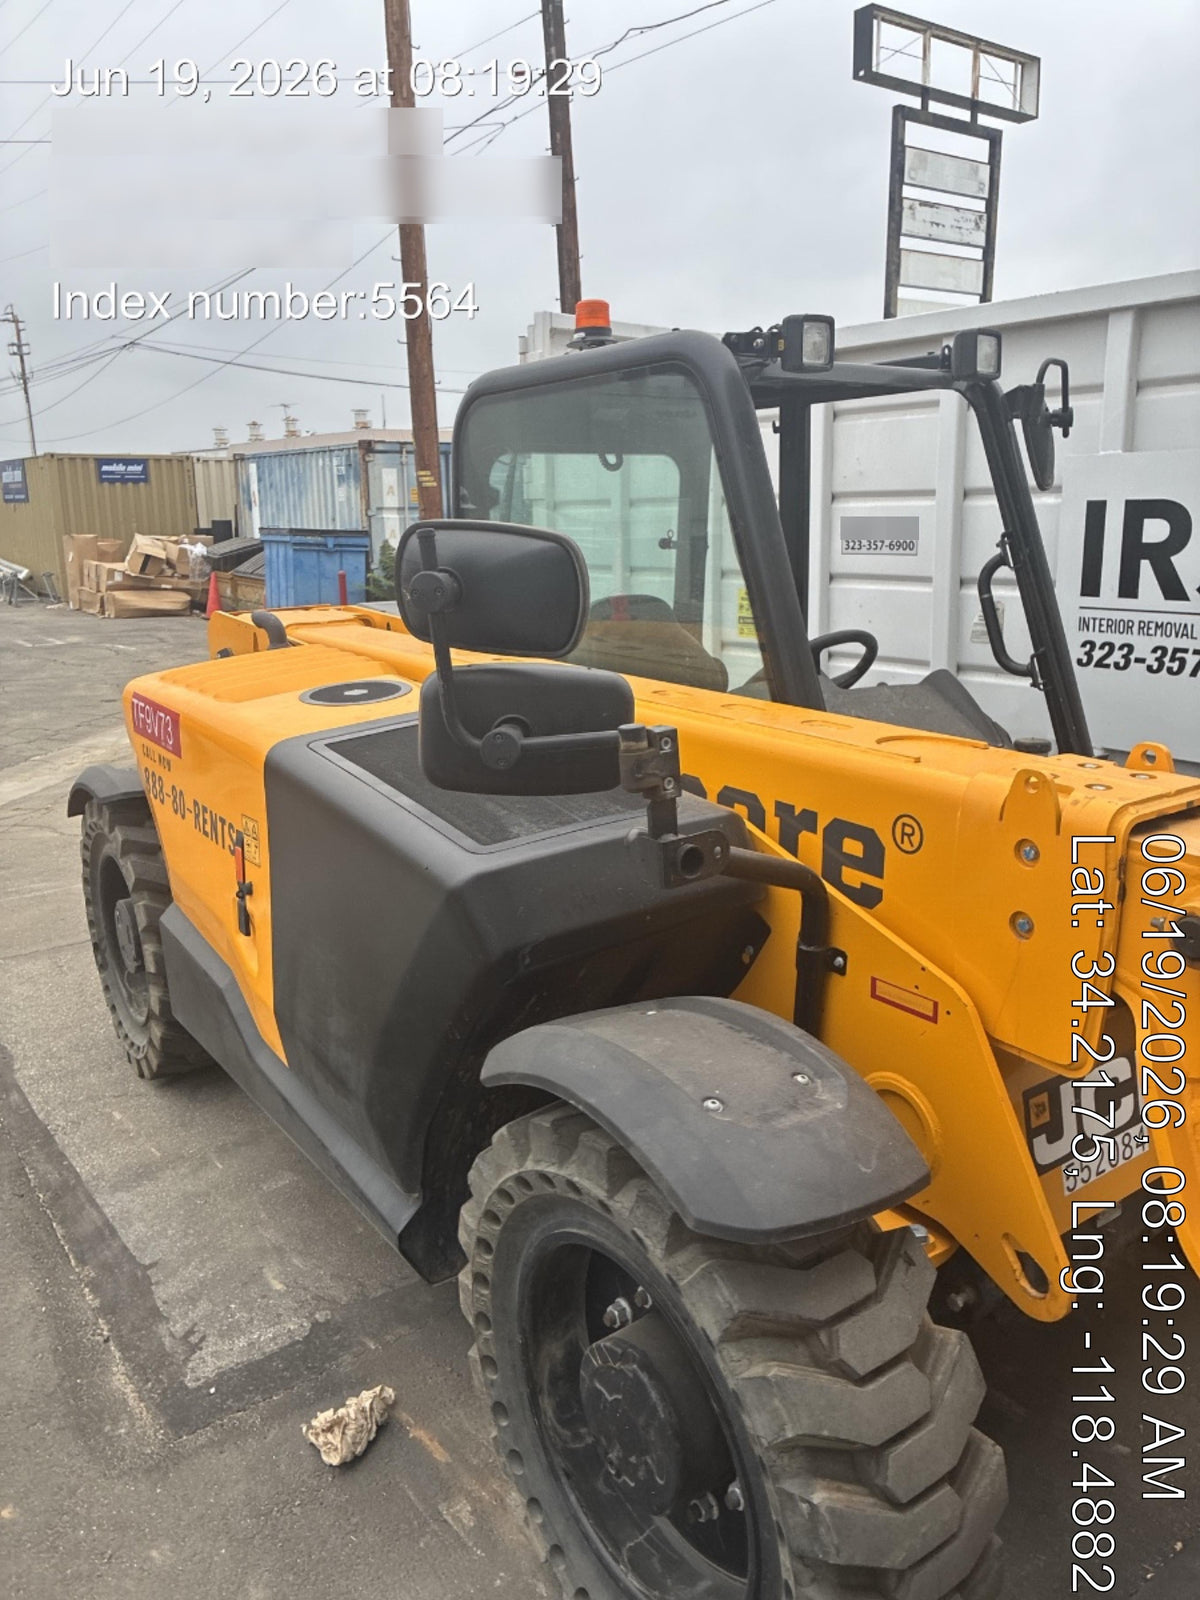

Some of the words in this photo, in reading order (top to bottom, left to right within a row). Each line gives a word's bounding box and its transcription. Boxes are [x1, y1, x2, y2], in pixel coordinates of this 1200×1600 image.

[844, 540, 915, 551] 323-357-6900
[1080, 499, 1200, 601] IR
[1078, 616, 1134, 635] INTERIOR
[1137, 620, 1197, 640] REMOVAL
[142, 743, 157, 763] CALL
[158, 753, 172, 772] NOW
[143, 767, 236, 856] 888-80-RENTS
[1032, 1056, 1144, 1165] JC
